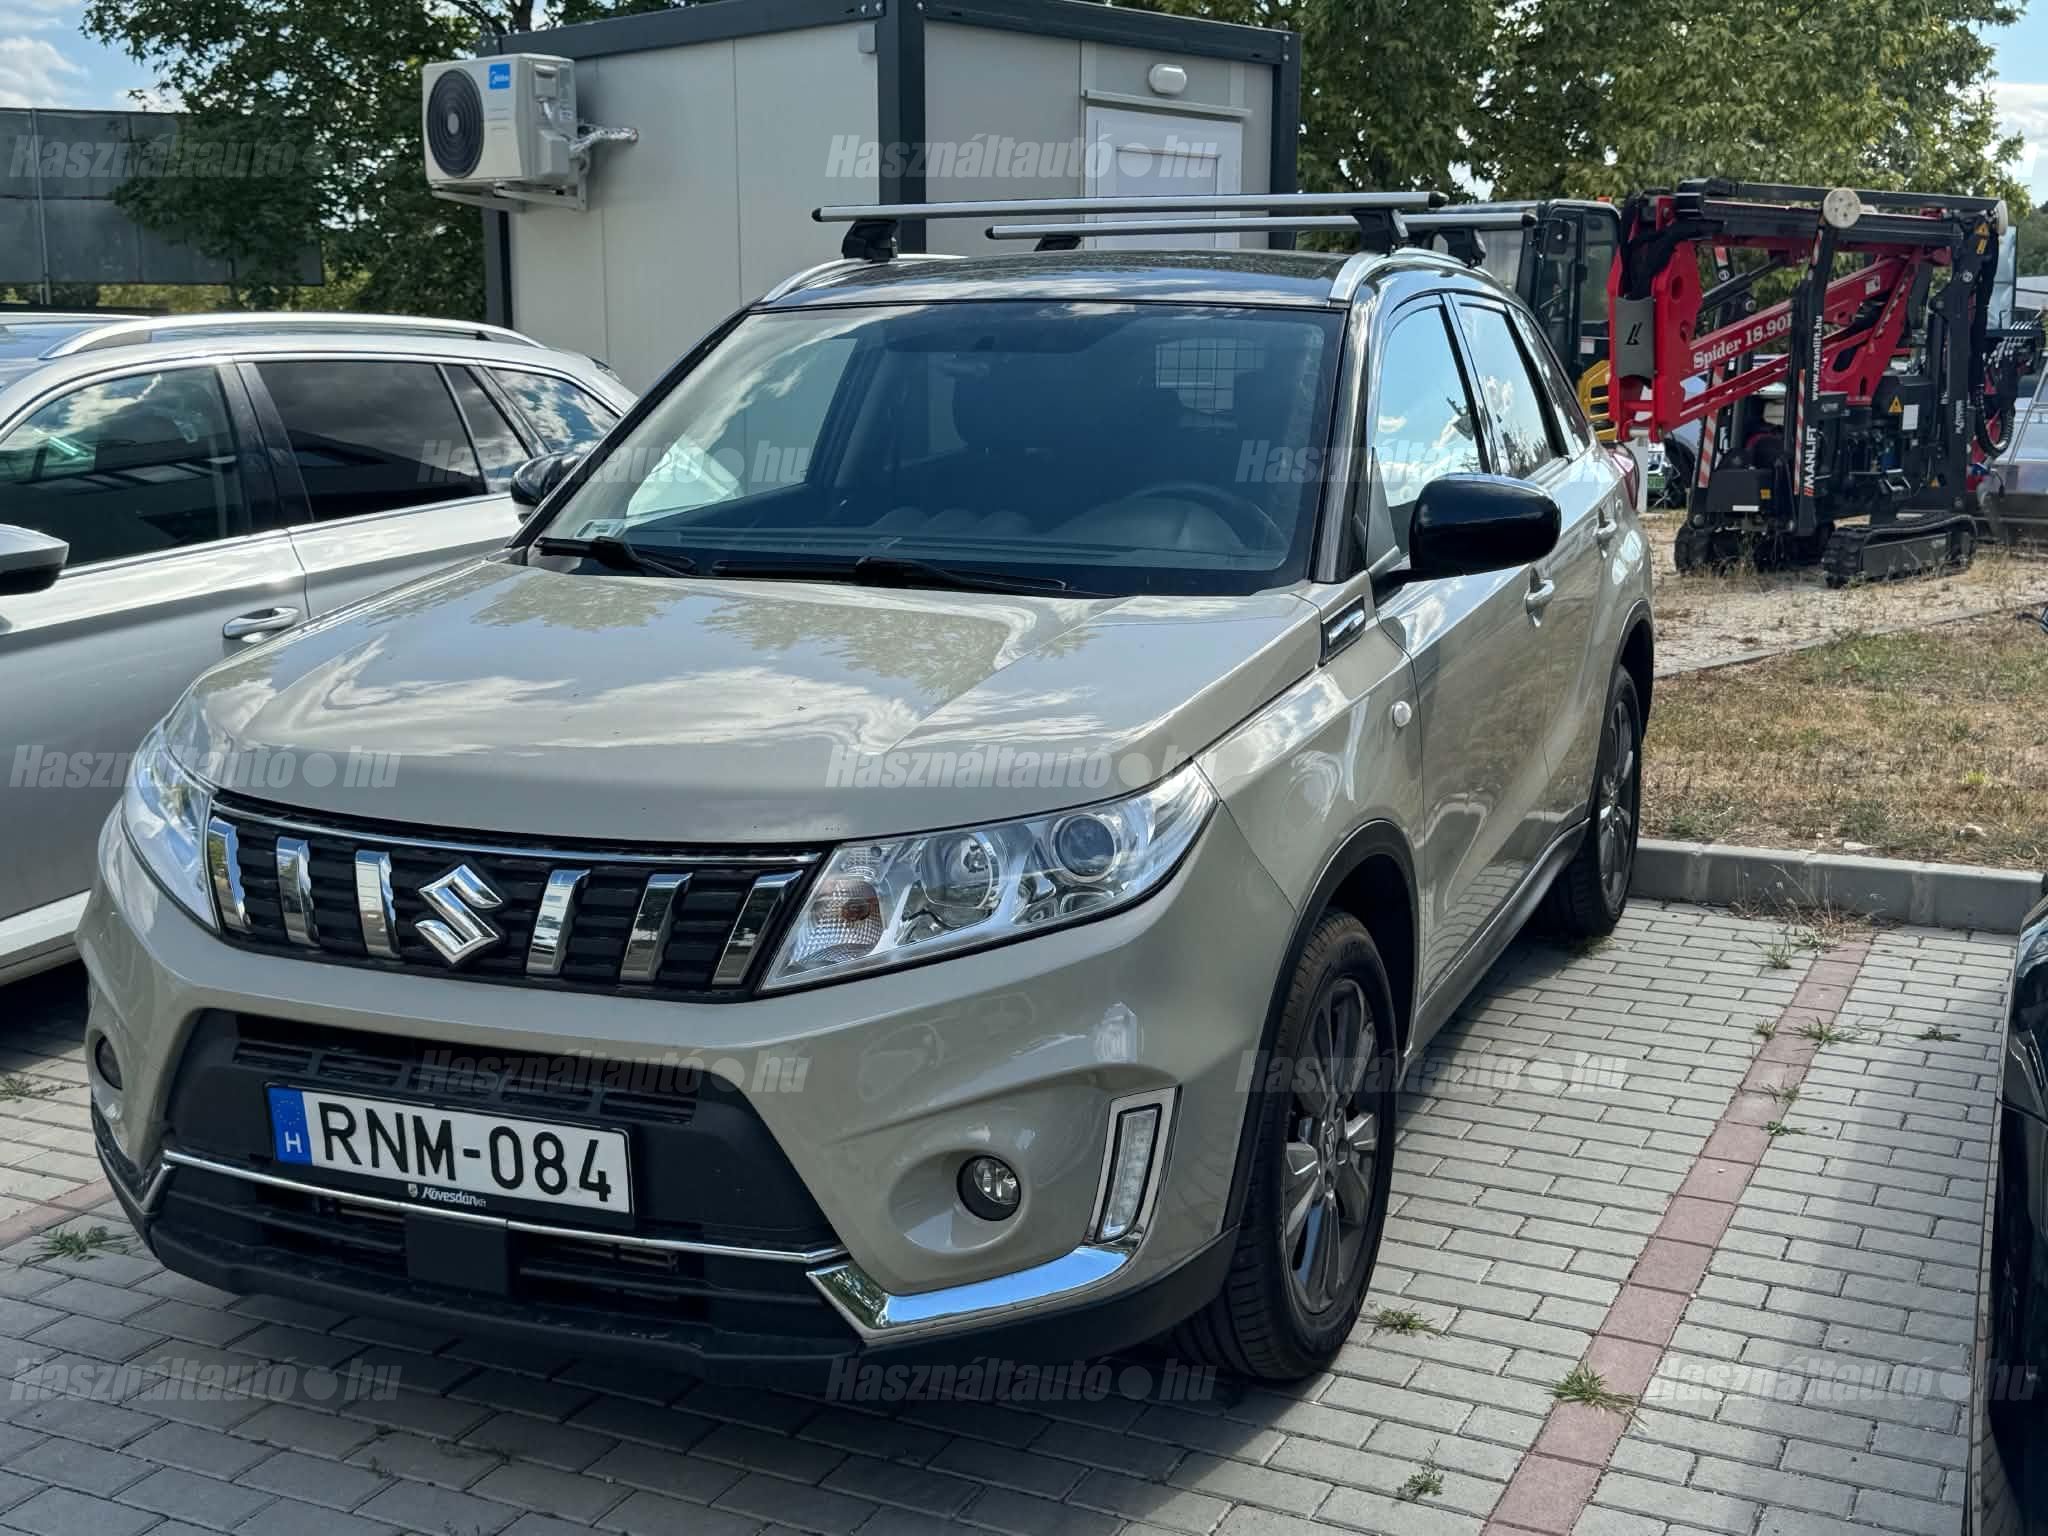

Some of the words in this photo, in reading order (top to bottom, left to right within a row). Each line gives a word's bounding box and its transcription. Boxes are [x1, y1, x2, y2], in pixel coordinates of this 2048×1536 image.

[1693, 338, 1742, 369] Spider
[1812, 315, 1823, 401] www.manlift.hu
[1804, 425, 1817, 489] MANLIFT
[284, 1131, 303, 1154] H
[317, 1101, 612, 1203] RNM-084
